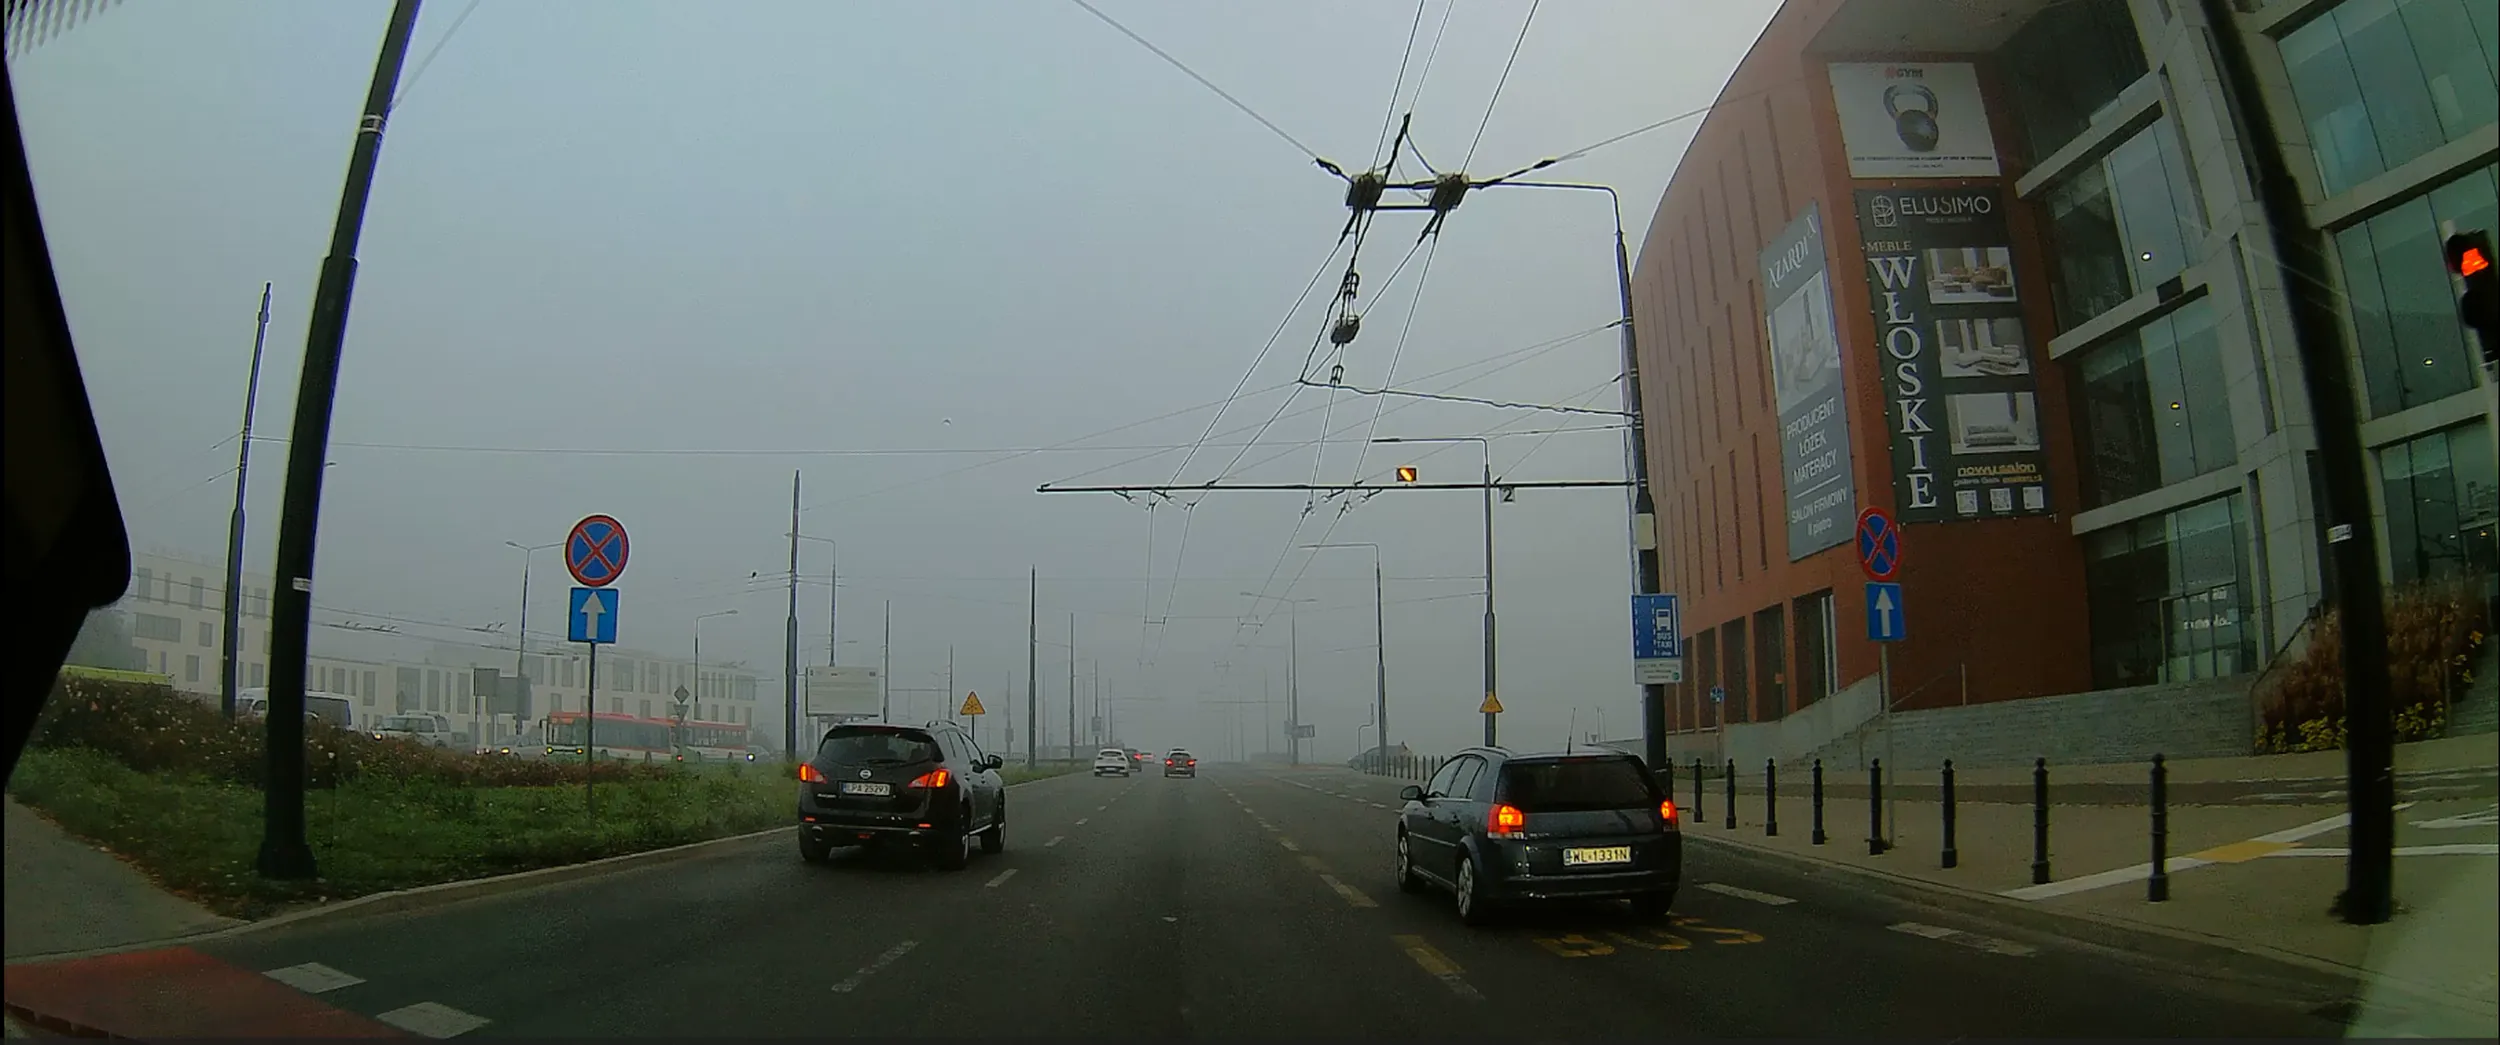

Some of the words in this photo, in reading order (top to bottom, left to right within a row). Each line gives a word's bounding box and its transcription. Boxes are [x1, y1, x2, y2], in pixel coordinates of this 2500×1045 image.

[1899, 195, 1992, 215] ELUSIMO
[1866, 240, 1913, 253] MEBLE
[1868, 256, 1937, 509] WŁOSKIE
[1786, 397, 1836, 441] PRODUCENT
[1793, 448, 1838, 486] MATERACY
[1502, 486, 1514, 502] 2
[1656, 631, 1673, 640] BUS
[1656, 640, 1674, 649] TAXI
[1593, 847, 1628, 862] 1331N
